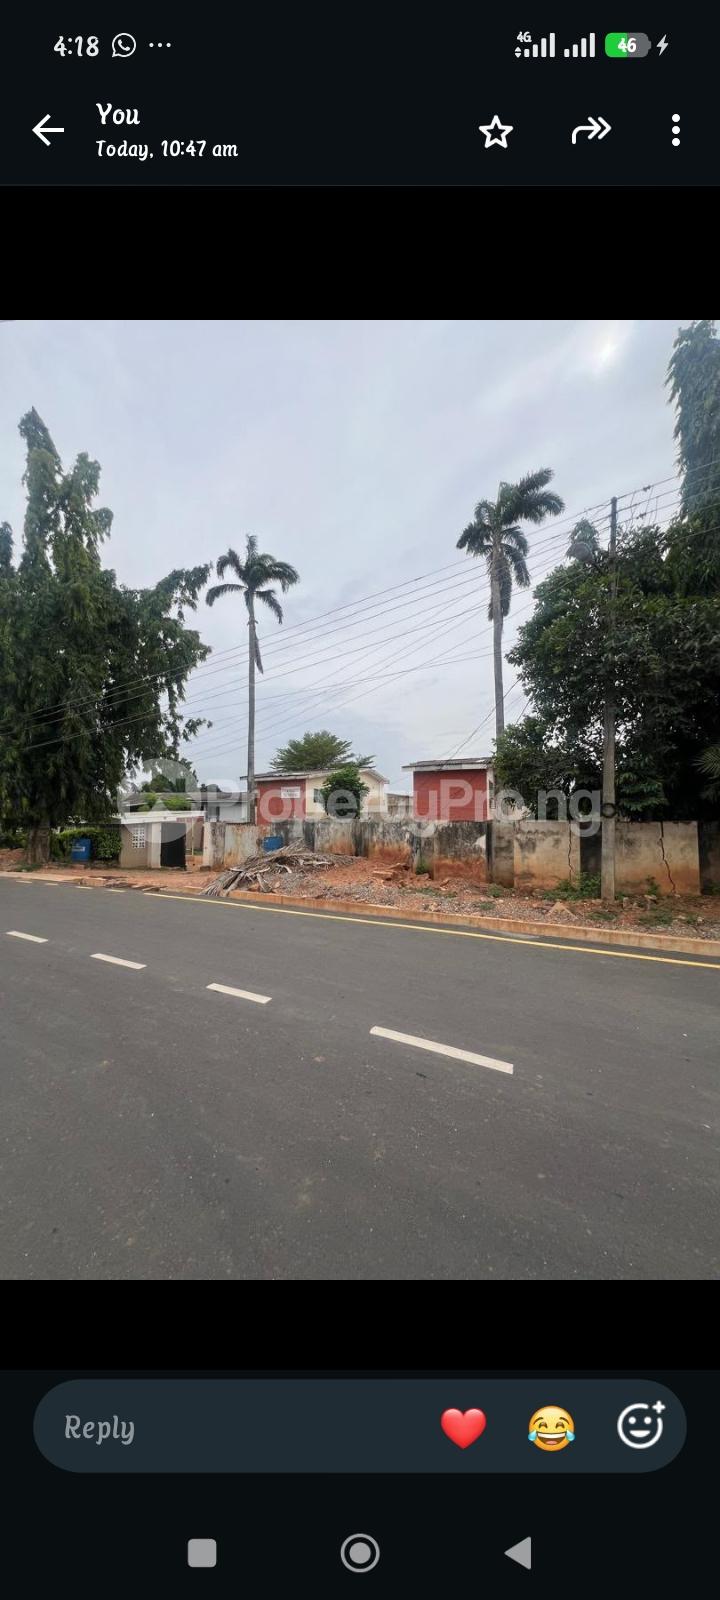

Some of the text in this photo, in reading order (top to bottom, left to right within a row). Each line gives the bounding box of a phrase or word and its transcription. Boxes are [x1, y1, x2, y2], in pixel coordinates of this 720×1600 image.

[54, 36, 99, 57] 4:18
[516, 31, 533, 43] 4G
[617, 37, 637, 53] 46
[96, 102, 140, 125] You
[96, 139, 238, 161] Today, 10:47 am
[65, 1415, 135, 1446] Reply
